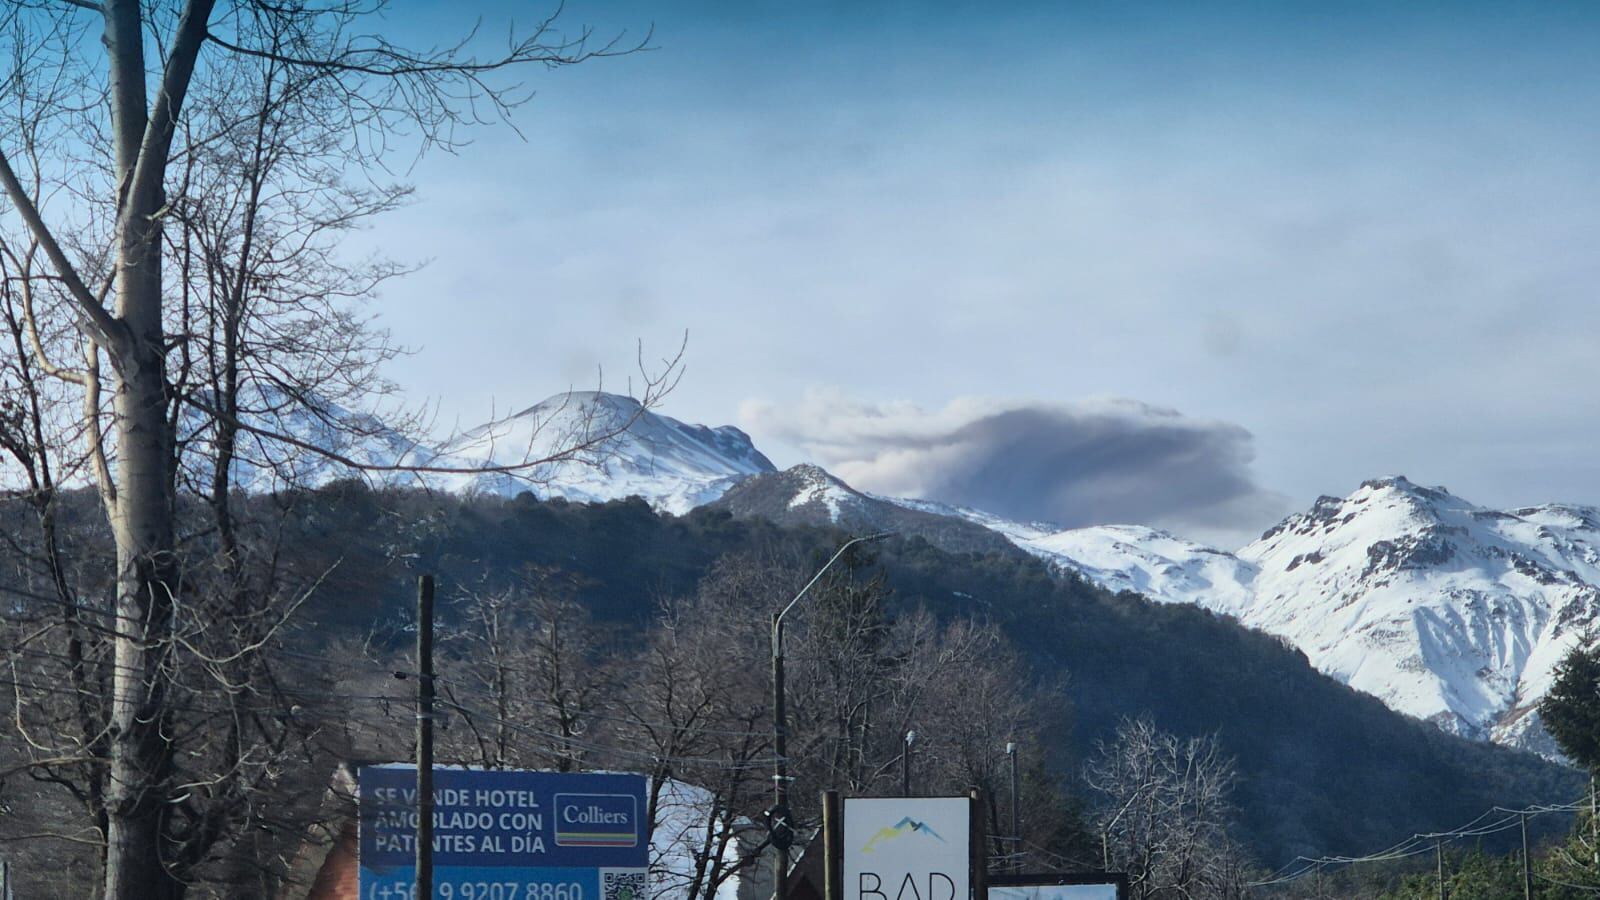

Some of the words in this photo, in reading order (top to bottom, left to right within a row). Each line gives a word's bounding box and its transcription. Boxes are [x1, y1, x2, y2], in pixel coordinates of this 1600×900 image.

[374, 787, 397, 805] SE
[402, 788, 470, 807] VNDE
[476, 790, 539, 808] HOTEL
[500, 813, 542, 831] CON
[563, 804, 628, 824] Colliers
[375, 834, 476, 853] PATNTES
[480, 836, 505, 853] AL
[511, 832, 546, 854] DÍA
[438, 882, 454, 900] 9
[460, 882, 519, 900] 9207
[525, 883, 583, 900] 8860
